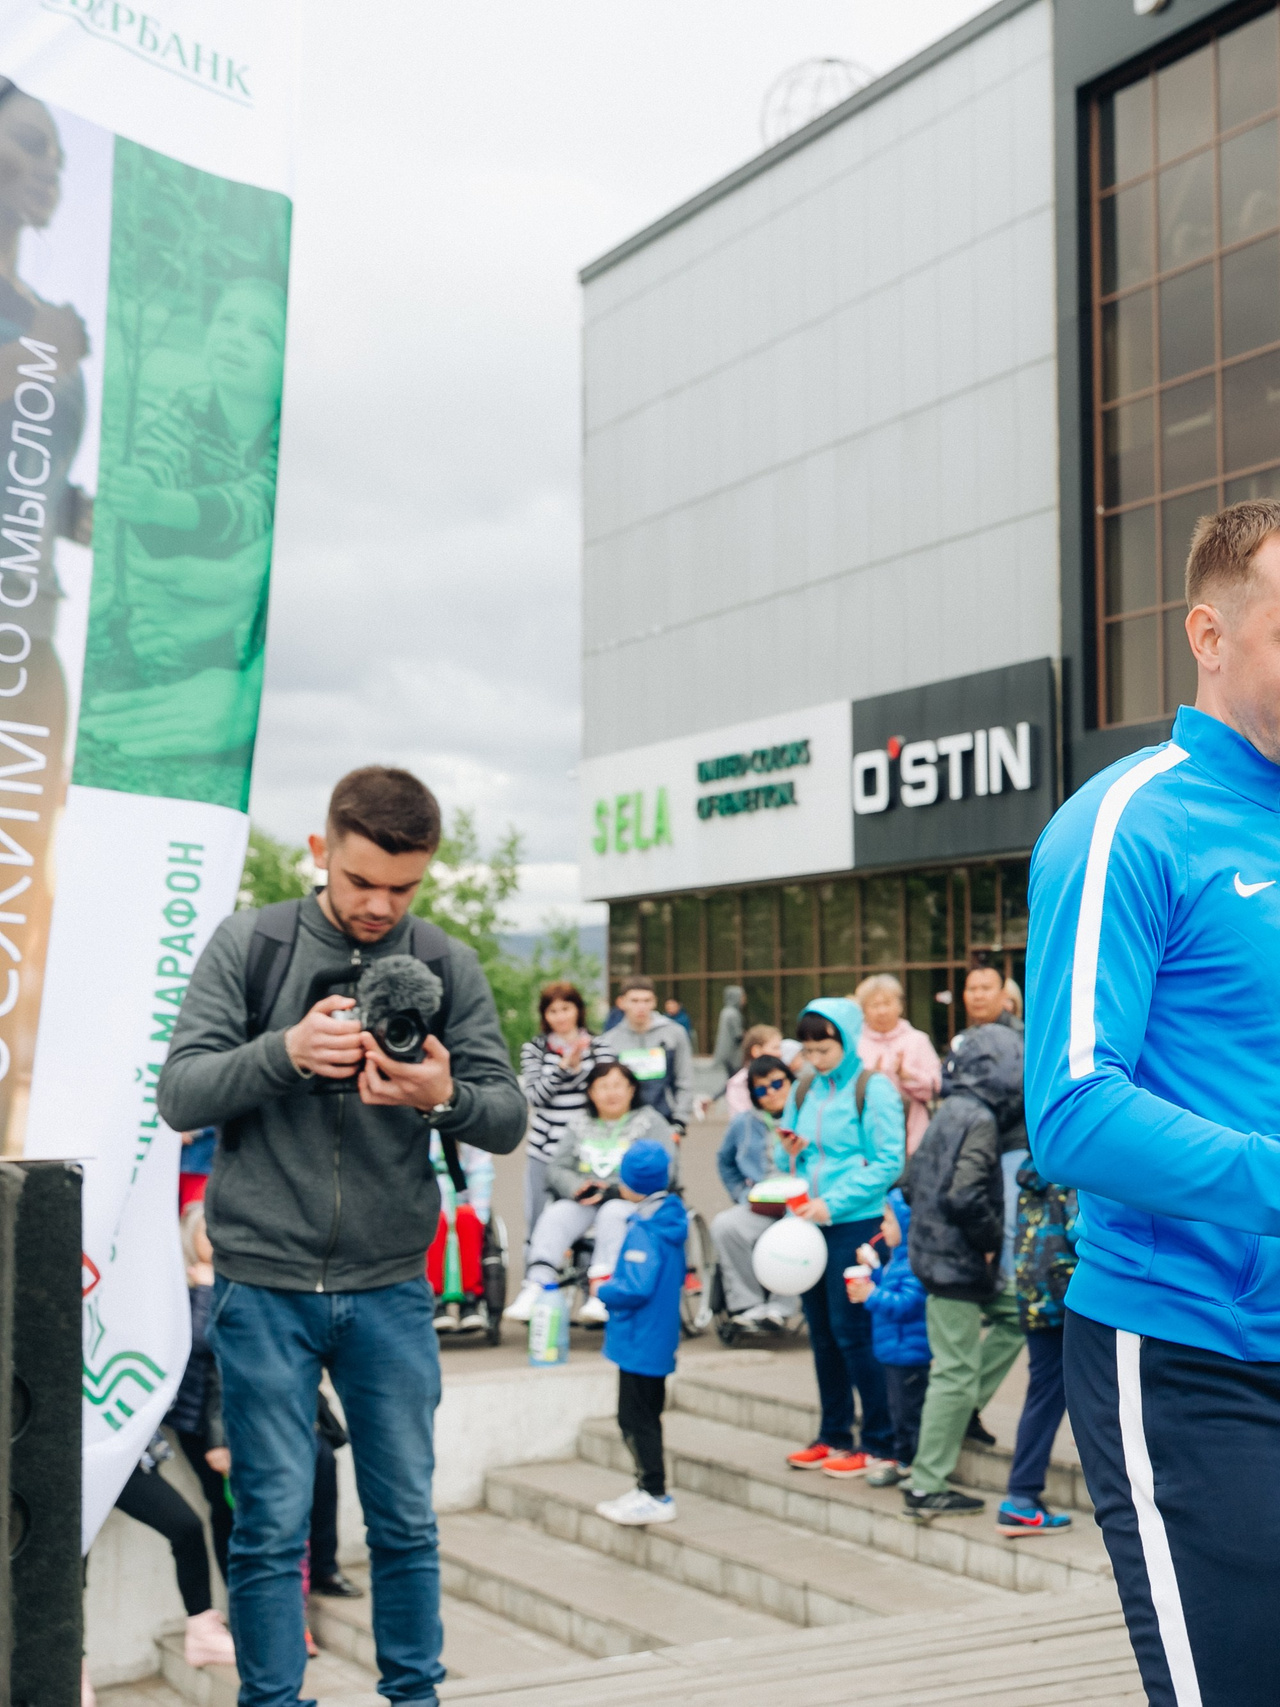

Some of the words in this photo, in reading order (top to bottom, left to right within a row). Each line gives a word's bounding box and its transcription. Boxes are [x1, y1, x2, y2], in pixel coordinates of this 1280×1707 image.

[852, 721, 1031, 815] O'STIN
[592, 785, 673, 855] SELA
[149, 840, 205, 1043] МАРАФОН
